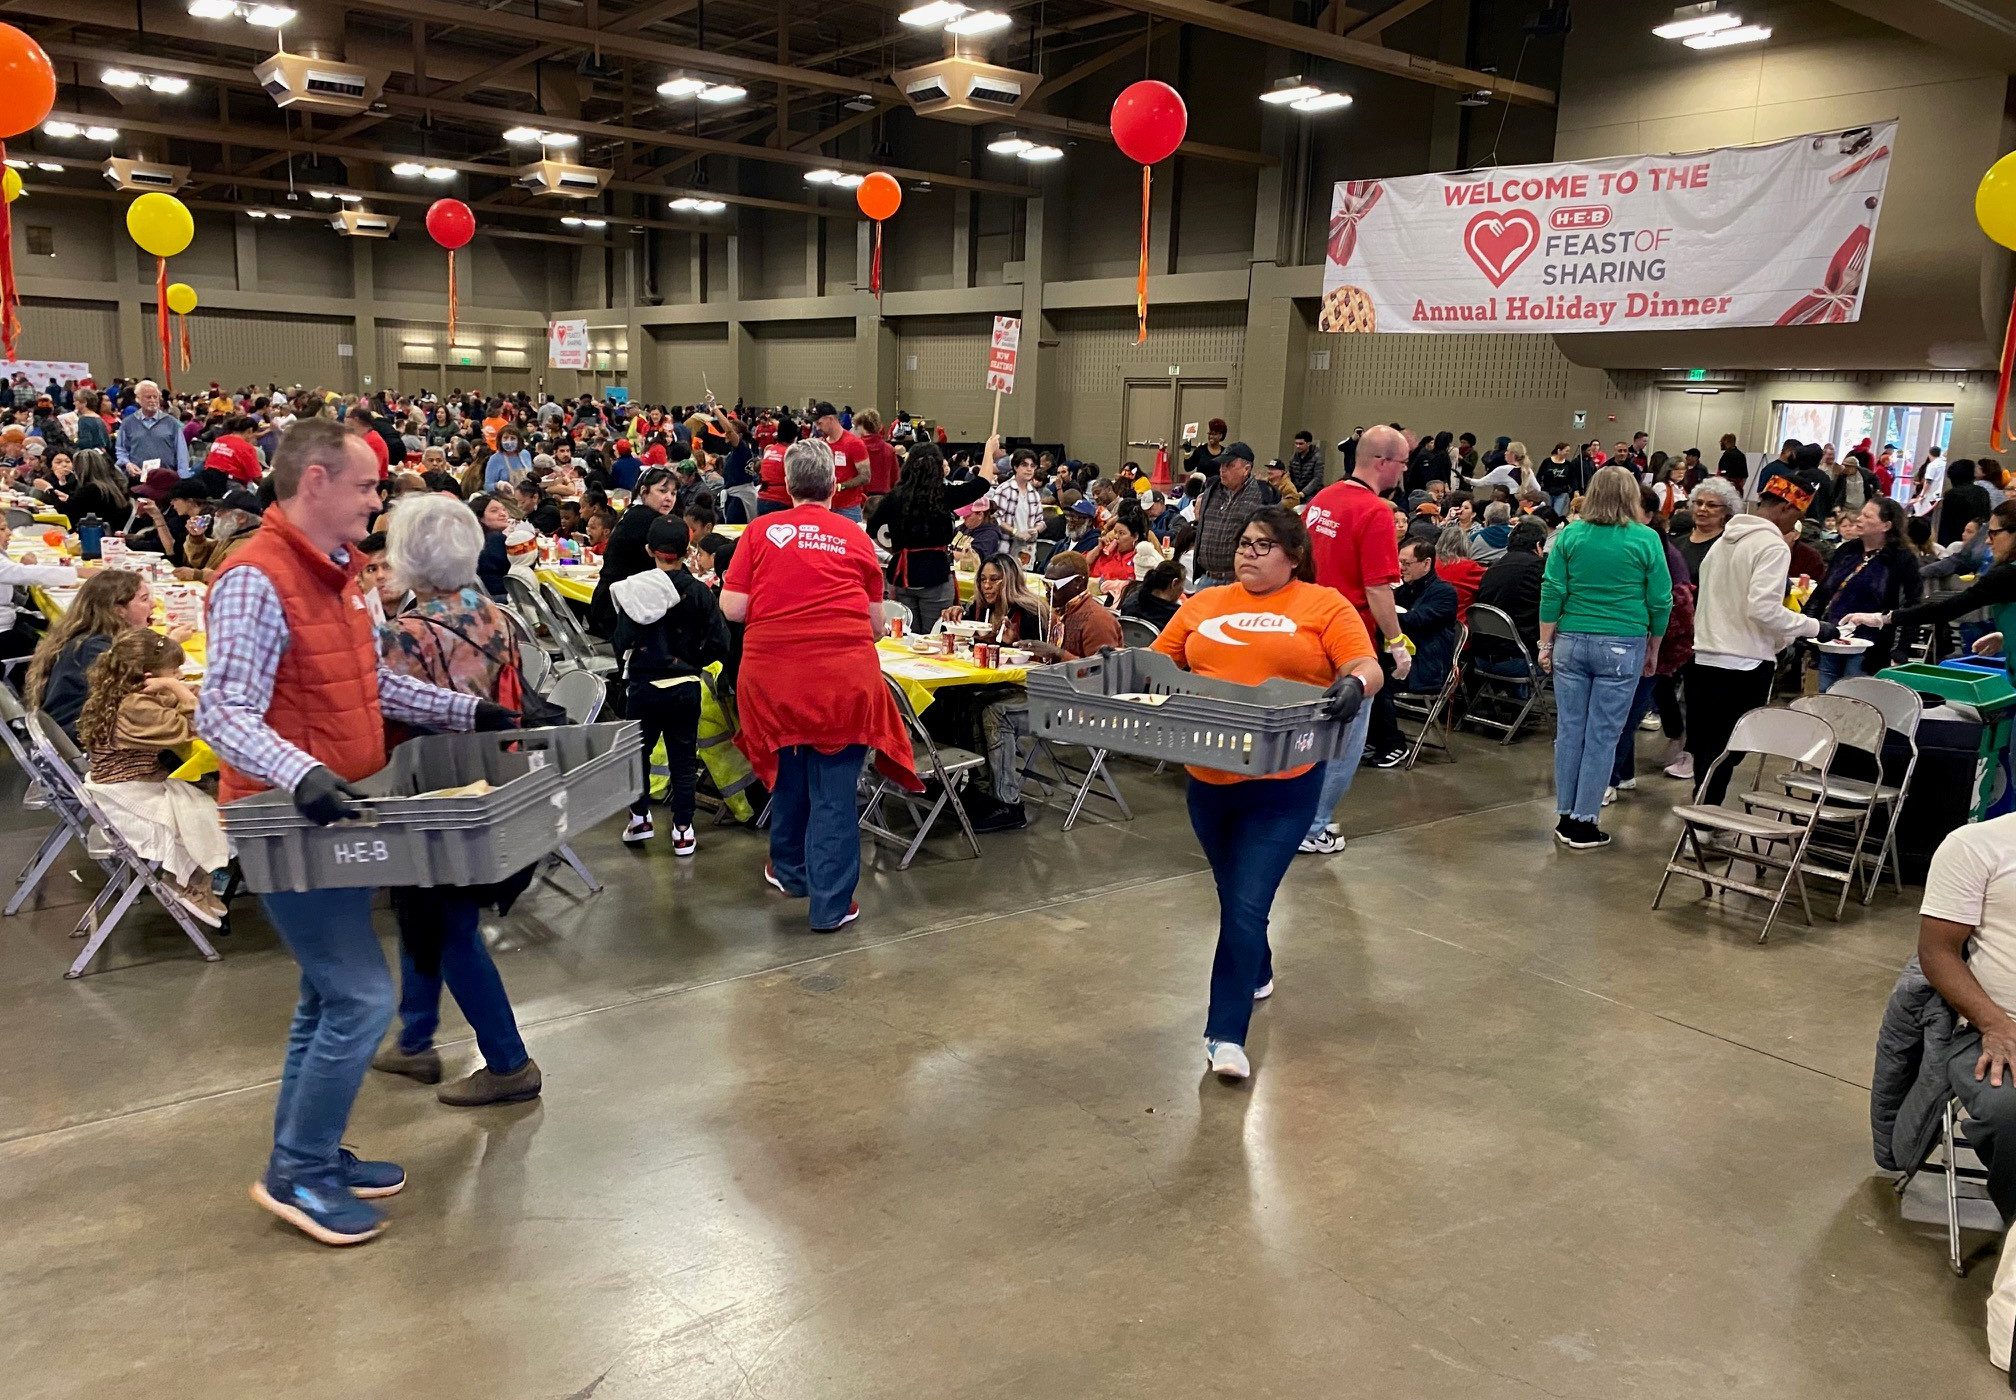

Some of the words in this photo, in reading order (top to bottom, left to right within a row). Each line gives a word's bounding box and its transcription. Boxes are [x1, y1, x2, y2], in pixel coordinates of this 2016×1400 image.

[1444, 175, 1589, 206] WELCOME
[1599, 170, 1638, 195] TO
[1648, 163, 1710, 191] THE
[1543, 259, 1666, 285] SHARING
[1412, 299, 1498, 321] Annual
[1505, 294, 1617, 326] Holiday
[1624, 291, 1733, 318] Dinner
[996, 351, 1010, 360] NOW
[990, 360, 1013, 371] SEATING
[797, 540, 846, 555] SHARING
[1238, 615, 1284, 627] ufcu
